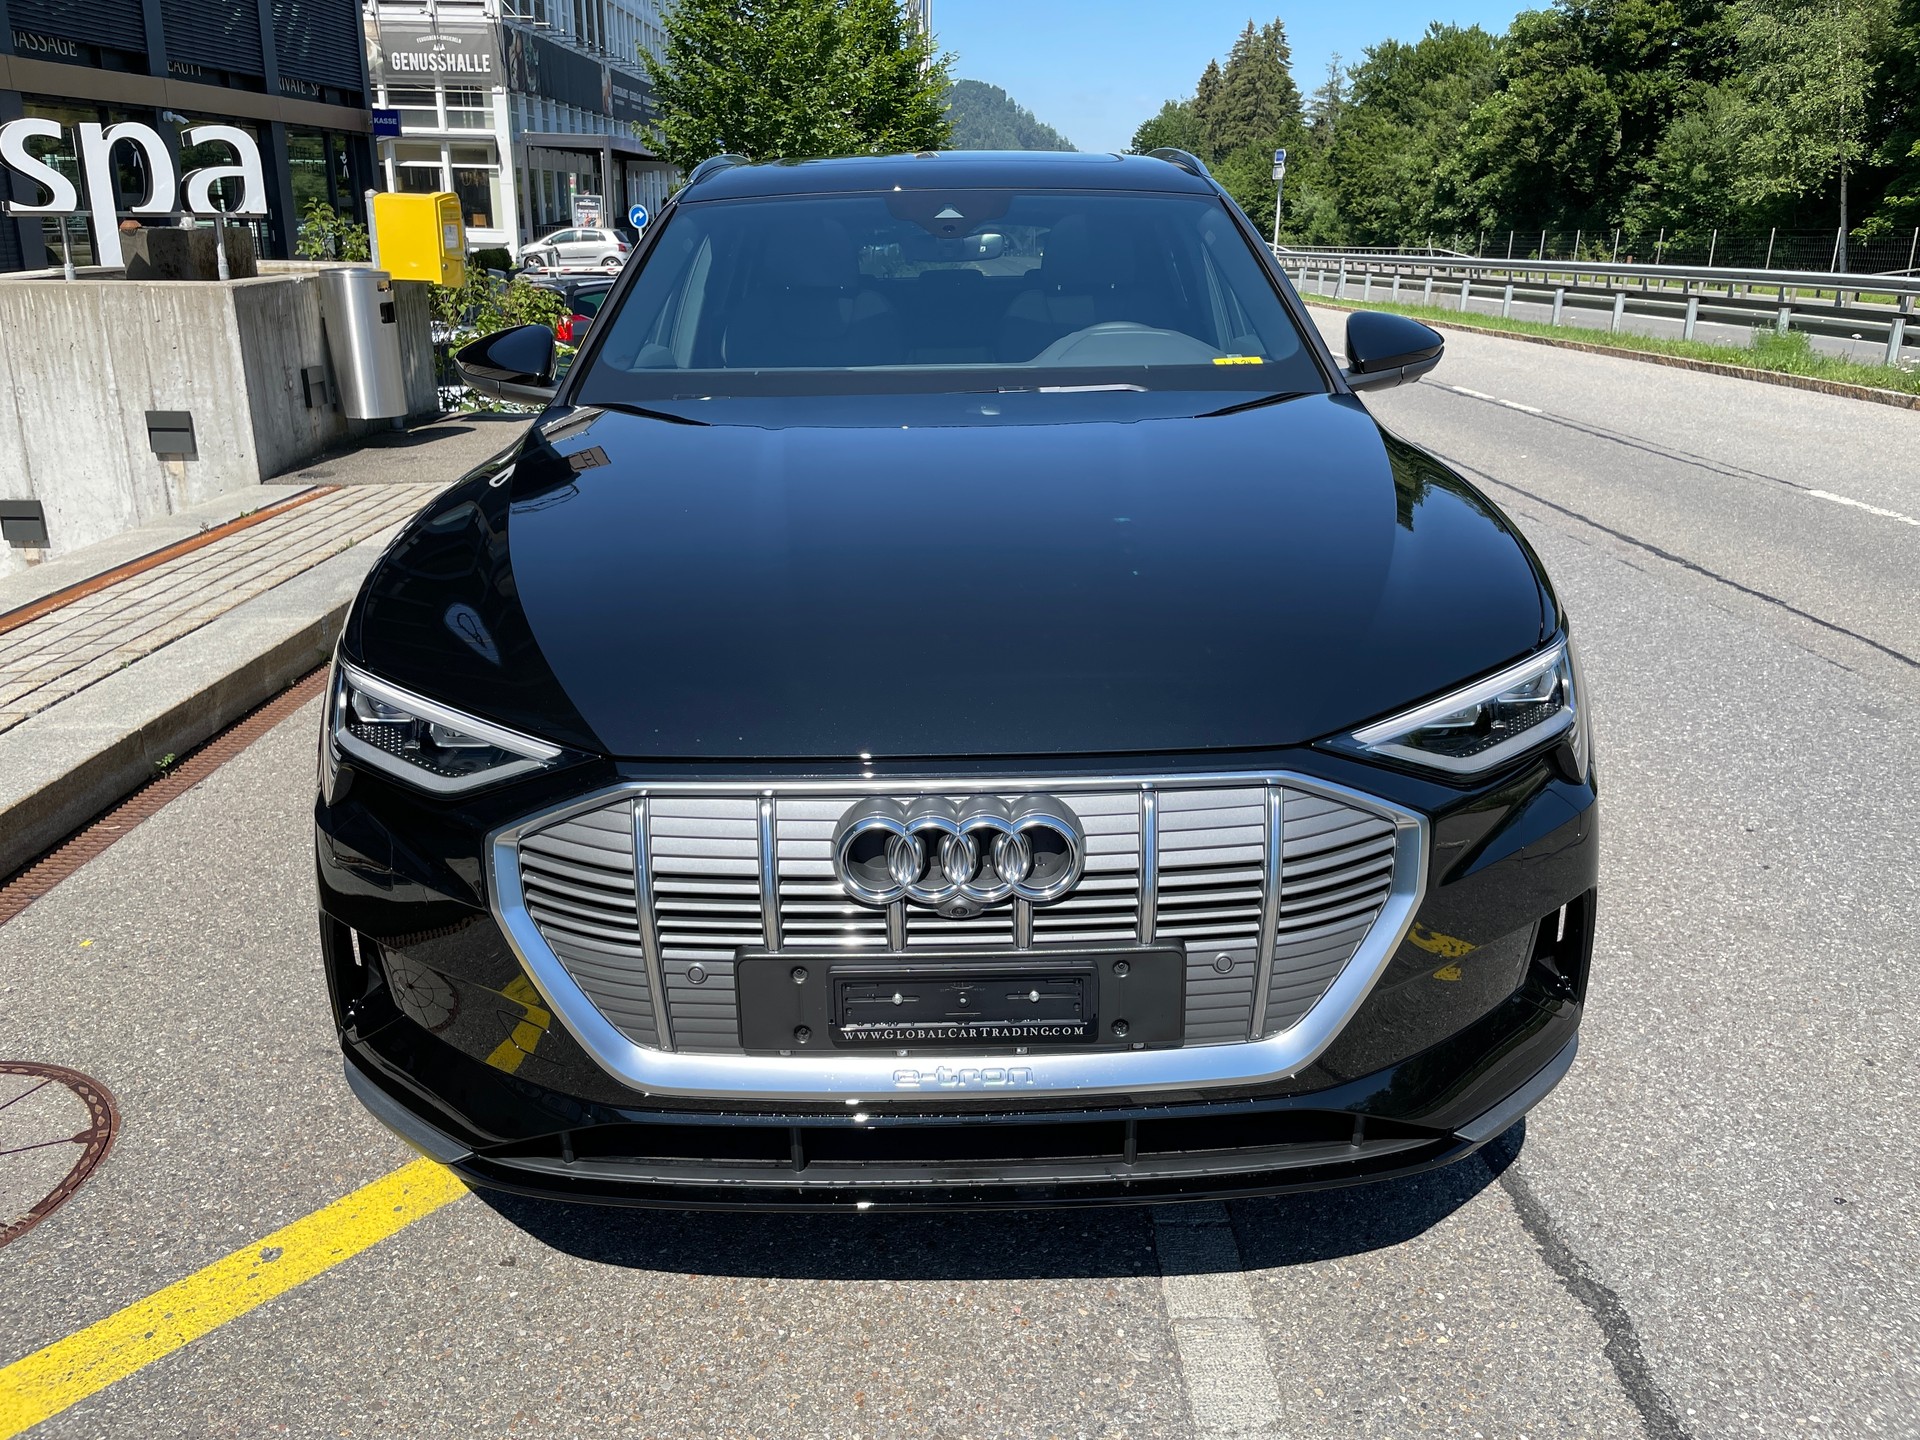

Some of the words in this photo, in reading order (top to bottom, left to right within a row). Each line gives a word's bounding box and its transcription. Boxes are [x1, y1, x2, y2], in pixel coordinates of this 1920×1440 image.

[391, 51, 491, 73] GENUSSHALLE
[373, 117, 398, 125] KASSE
[0, 117, 268, 268] spa
[892, 1065, 1035, 1087] e-tron
